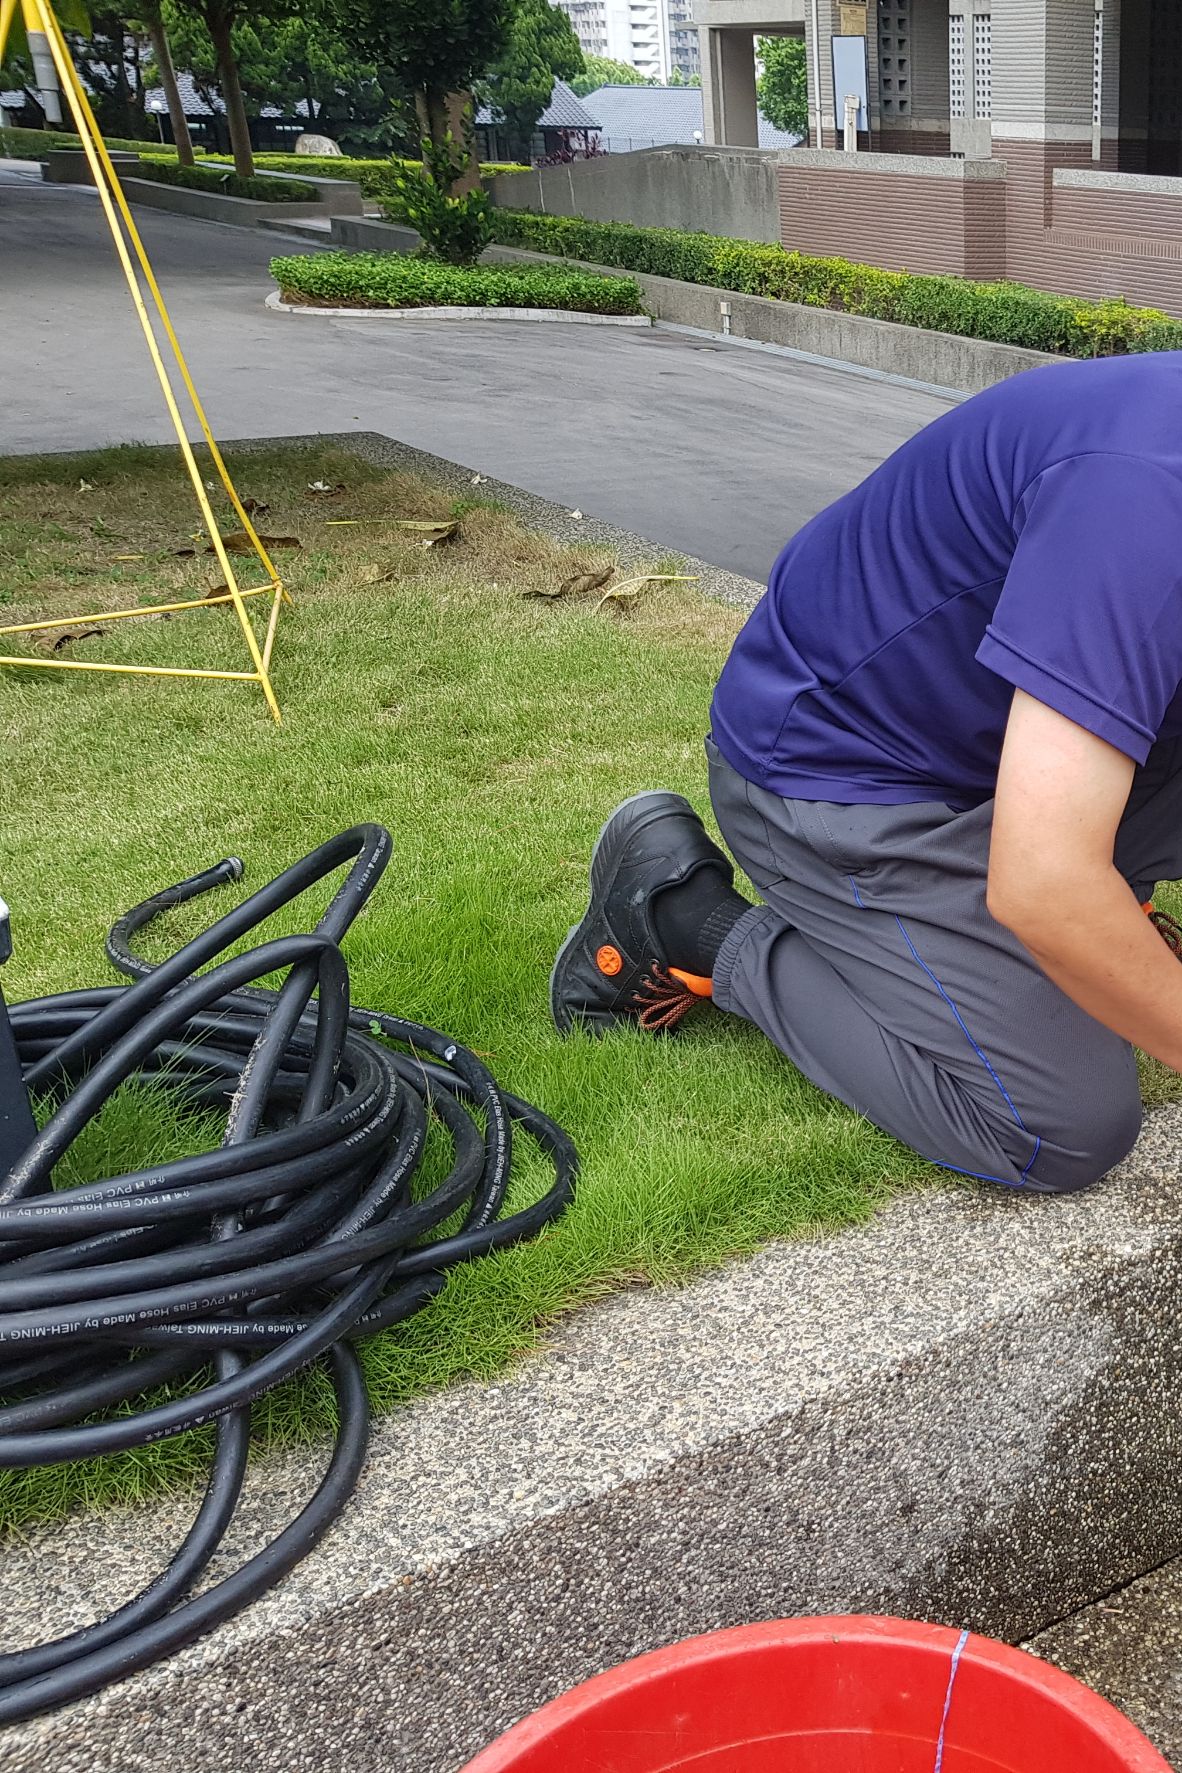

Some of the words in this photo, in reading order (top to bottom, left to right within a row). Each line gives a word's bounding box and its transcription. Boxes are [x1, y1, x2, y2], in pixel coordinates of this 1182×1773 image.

[106, 1184, 133, 1197] PVC
[78, 1191, 104, 1202] Elas
[134, 1194, 159, 1207] PVC
[72, 1202, 103, 1212] Hose
[106, 1199, 131, 1209] Elas
[17, 1208, 32, 1217] by
[35, 1206, 68, 1216] Made
[173, 1301, 198, 1312] Elas
[201, 1297, 226, 1308] PVC
[140, 1308, 169, 1319] Hose
[84, 1318, 99, 1329] by
[103, 1313, 136, 1326] Made
[10, 1322, 81, 1340] JIEH-MING
[187, 1324, 249, 1335] JIEH-MING
[252, 1323, 265, 1333] by
[268, 1325, 294, 1334] Made
